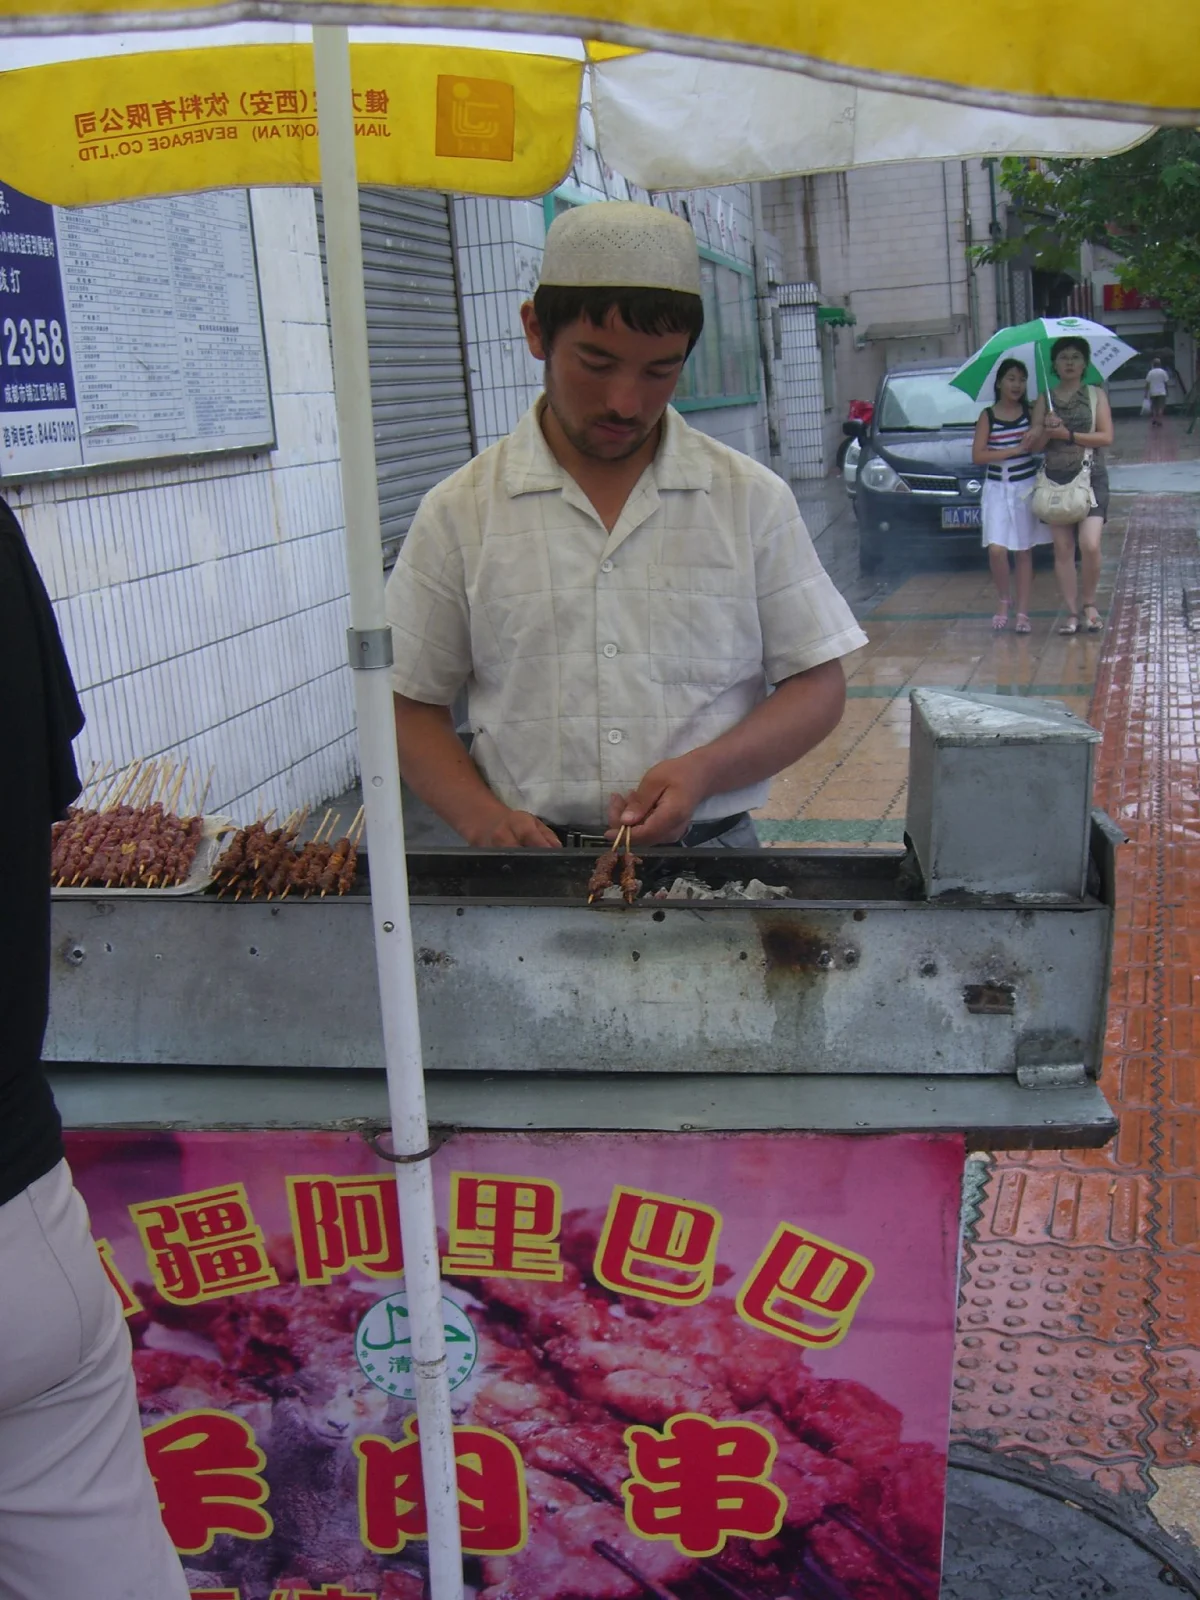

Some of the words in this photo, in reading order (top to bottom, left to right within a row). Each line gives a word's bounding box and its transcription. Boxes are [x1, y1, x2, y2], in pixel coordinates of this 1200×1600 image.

[0, 318, 65, 366] 2358
[96, 1171, 875, 1350] 疆阿里巴巴
